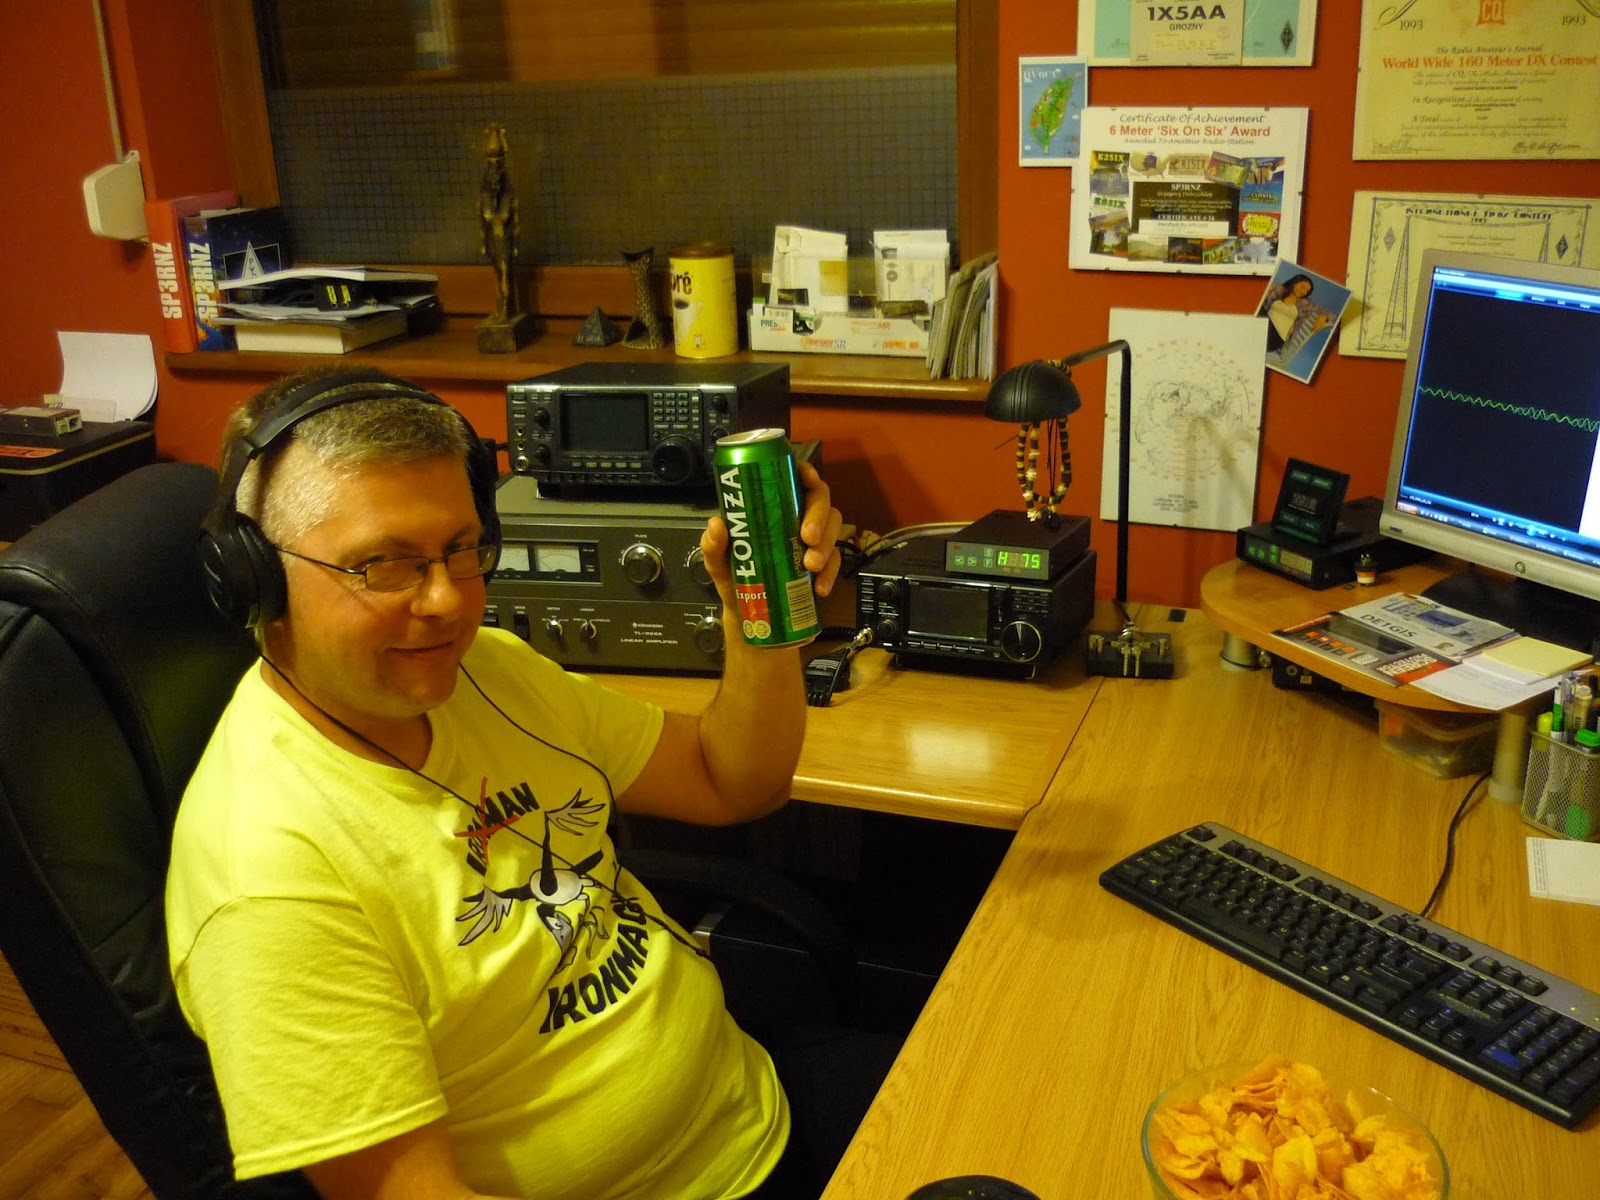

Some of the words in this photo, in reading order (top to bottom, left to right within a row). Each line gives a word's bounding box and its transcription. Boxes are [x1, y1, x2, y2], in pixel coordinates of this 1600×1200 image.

[1147, 5, 1226, 21] 1X5AA
[1399, 20, 1423, 31] 1993
[1562, 15, 1586, 26] 1993
[1169, 23, 1204, 31] GROZNY
[1382, 57, 1419, 69] World
[1423, 57, 1454, 69] Wide
[1458, 56, 1483, 68] 160
[1487, 56, 1522, 68] Meter
[1527, 54, 1546, 66] DX
[1549, 53, 1598, 66] Contest
[1119, 113, 1176, 124] Certificate
[1178, 113, 1193, 125] Of
[1194, 114, 1266, 123] Achievement
[1109, 125, 1116, 136] 6
[1119, 125, 1153, 136] Meter
[1183, 126, 1200, 136] On
[1230, 126, 1271, 137] Award
[1097, 153, 1125, 162] K2SIX
[152, 242, 182, 319] SP3RNZ
[189, 242, 219, 318] SP3RNZ
[997, 551, 1008, 565] H
[1022, 553, 1040, 568] 75
[736, 589, 767, 602] Export
